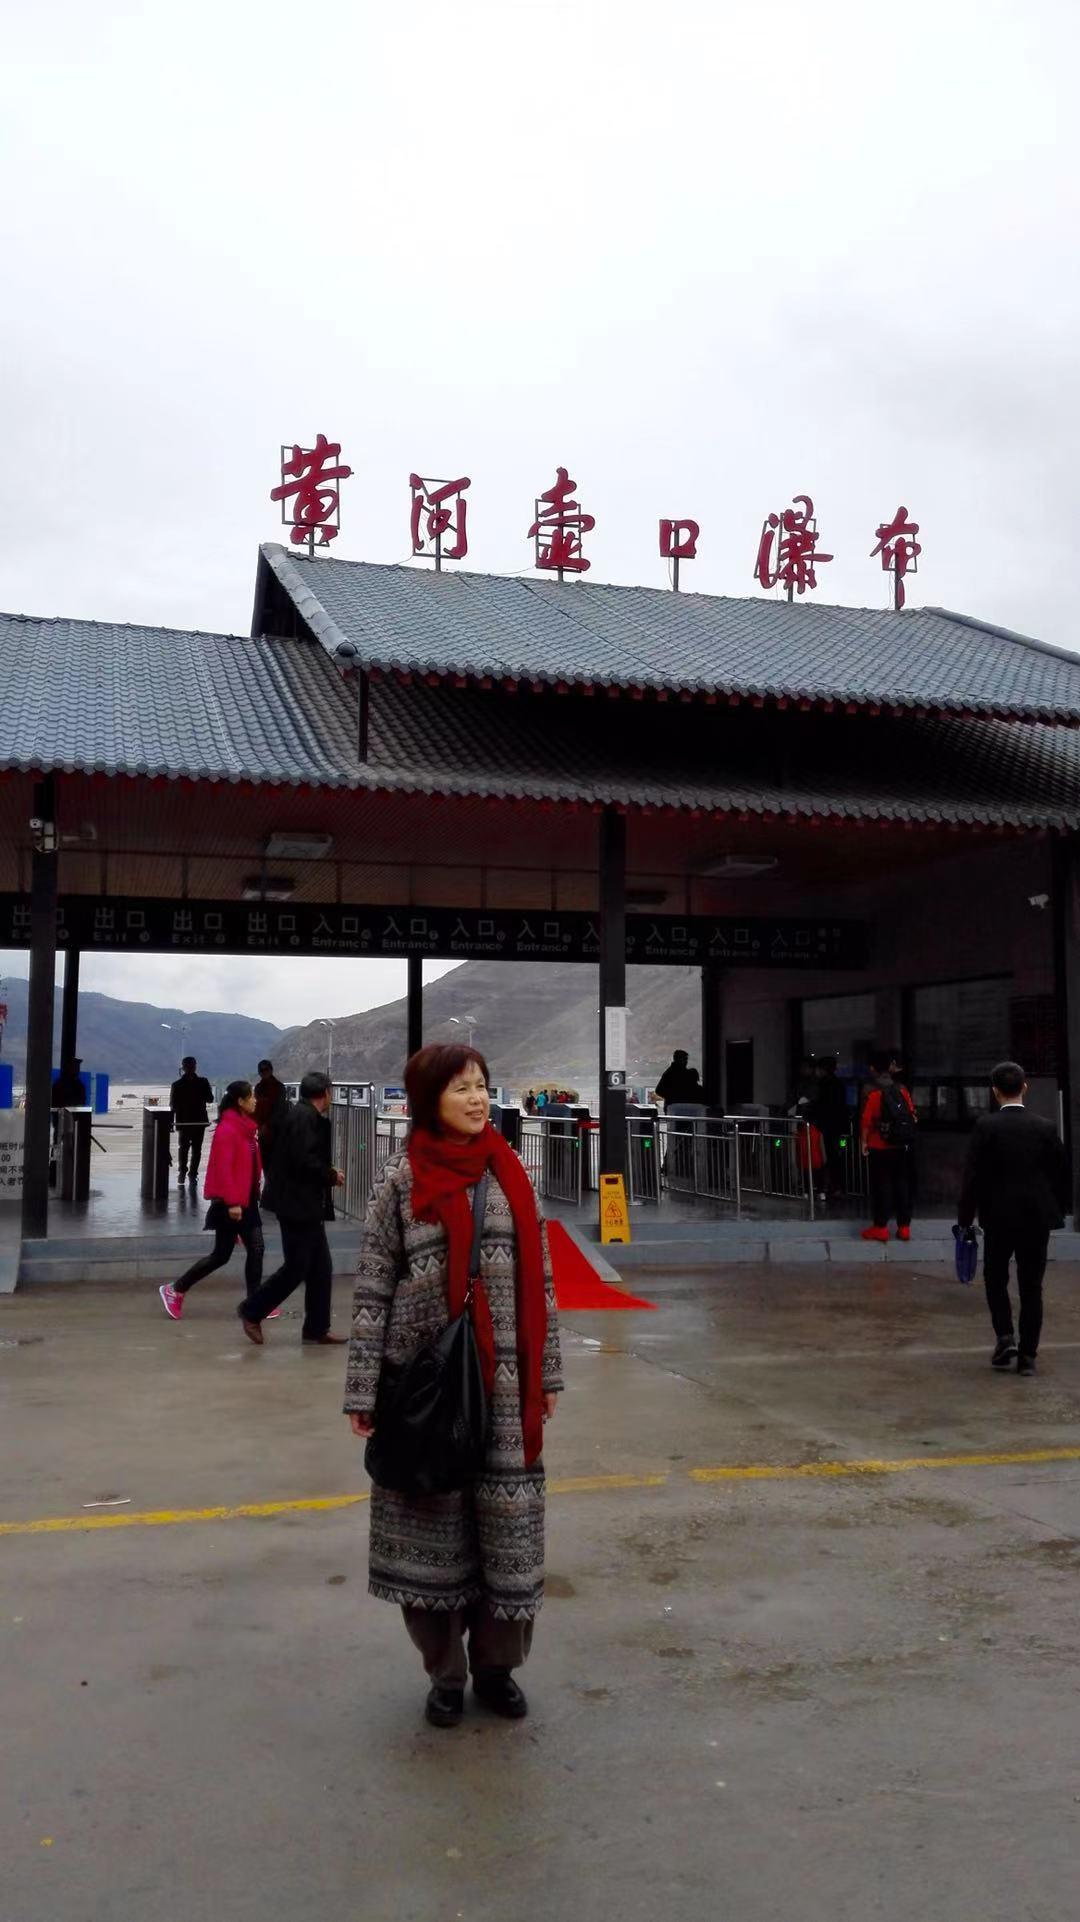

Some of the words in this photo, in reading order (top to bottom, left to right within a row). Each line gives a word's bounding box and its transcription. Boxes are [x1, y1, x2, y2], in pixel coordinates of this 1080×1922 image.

[94, 908, 145, 928] 出口
[173, 911, 221, 930] 出口
[247, 912, 296, 932] 出口
[313, 913, 358, 933] 入口
[382, 916, 426, 935] 入口
[450, 918, 494, 936] 入口
[517, 920, 559, 938] 入口
[646, 923, 687, 942] 入口
[93, 931, 126, 941] Exit
[172, 934, 204, 944] Exit
[247, 936, 278, 945] Exit
[312, 937, 368, 949] Entrance
[710, 928, 748, 944] 入口
[382, 939, 436, 950] Entrance
[450, 941, 502, 951] Entrance
[517, 942, 568, 952] Entrance
[611, 1072, 620, 1085] 6
